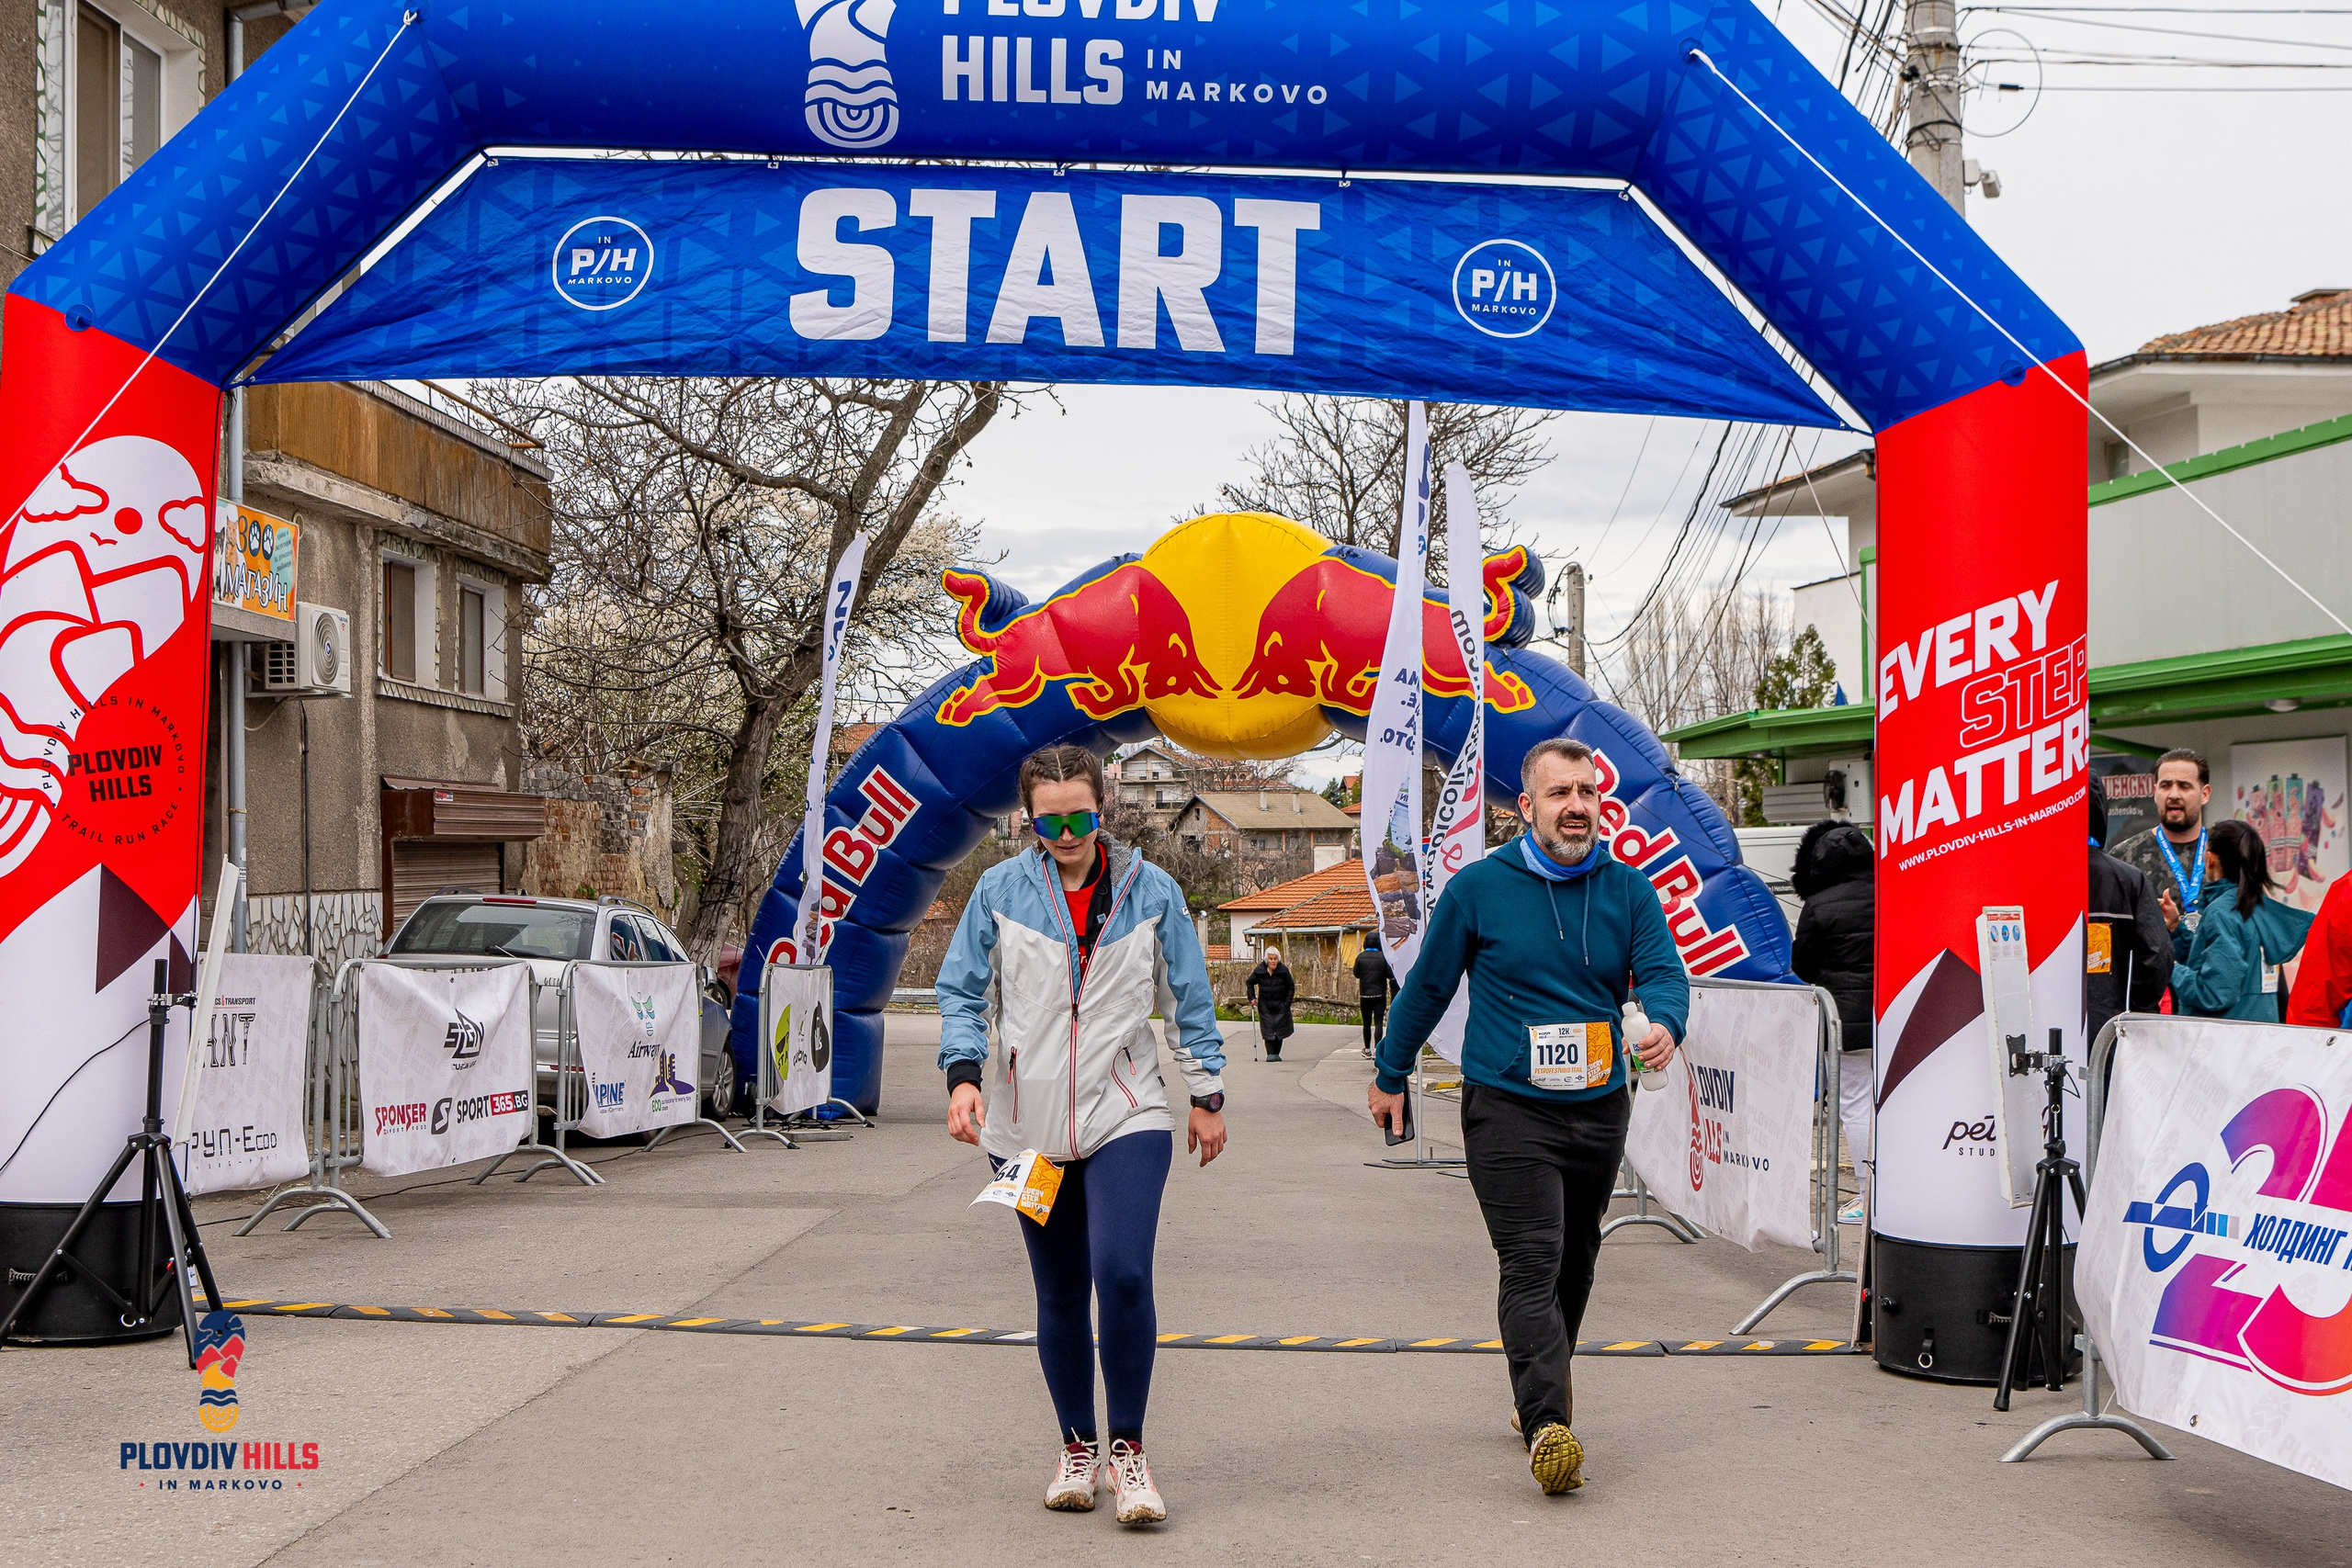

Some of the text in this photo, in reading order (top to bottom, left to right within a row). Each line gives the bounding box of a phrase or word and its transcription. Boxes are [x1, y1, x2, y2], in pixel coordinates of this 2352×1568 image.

[942, 35, 1124, 106] HILLS
[1147, 50, 1181, 69] IN
[1147, 81, 1328, 105] MARKOVO
[598, 236, 611, 244] IN
[571, 248, 638, 276] P/H
[789, 187, 1320, 356] START
[1498, 259, 1511, 267] IN
[567, 276, 632, 285] MARKOVO
[1472, 268, 1537, 302] P/H
[1471, 304, 1536, 316] MARKOVO
[225, 562, 288, 613] МАГАЗИН
[1880, 580, 2060, 723] EVERY
[1960, 634, 2088, 749] STEP
[42, 695, 185, 790] PLOVDIV HILLS IN MARKOVO
[67, 744, 163, 776] PLOVDIV
[89, 774, 153, 803] HILLS
[1881, 698, 2089, 860] MATTER
[61, 802, 178, 845] TRAIL RUN RACE
[824, 764, 922, 887] Bull
[1898, 785, 2086, 872] WWW.PLOVDIV-HILLS-IN-MARKOVO.COM
[1648, 854, 1751, 976] Bull
[225, 997, 256, 1006] TRANSPORT
[1558, 1027, 1570, 1035] 12K
[1536, 1043, 1578, 1066] 1120
[375, 1102, 427, 1136] SPONSER
[1723, 1130, 1730, 1144] IN
[989, 1164, 1022, 1184] 64
[2243, 1213, 2349, 1265] ХОЛДИНГ
